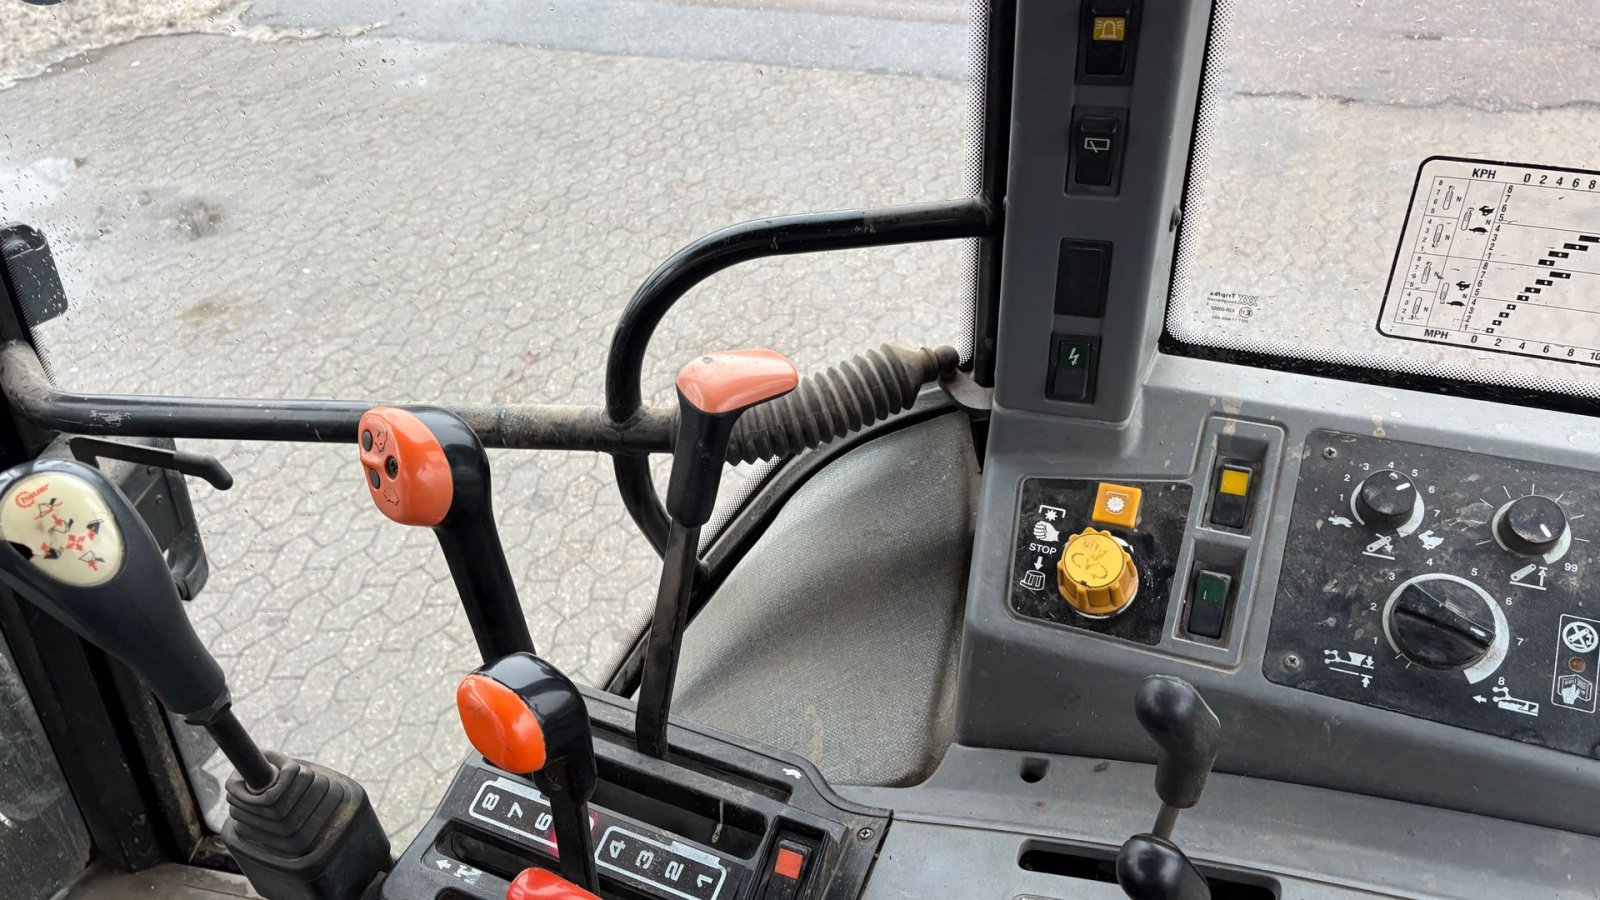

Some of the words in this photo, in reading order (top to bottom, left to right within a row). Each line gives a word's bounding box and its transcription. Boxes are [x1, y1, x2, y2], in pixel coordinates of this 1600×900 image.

[1472, 168, 1496, 179] KPH
[1524, 174, 1531, 183] 0
[1540, 175, 1548, 184] 2
[1556, 177, 1564, 186] 4
[1572, 178, 1580, 188] 6
[1588, 180, 1596, 190] 8
[1507, 185, 1514, 194] 8
[1424, 329, 1448, 339] MPH
[1471, 335, 1478, 344] 0
[1494, 338, 1502, 346] 2
[1518, 342, 1526, 350] 4
[1543, 345, 1550, 354] 6
[1567, 348, 1574, 357] 8
[1412, 469, 1418, 477] 5
[1029, 542, 1056, 555] STOP
[1471, 568, 1478, 576] 5
[1564, 562, 1578, 572] 99
[1389, 572, 1396, 580] 3
[1506, 598, 1512, 606] 6
[1518, 638, 1524, 646] 7
[1498, 677, 1505, 685] 8
[482, 792, 500, 811] 8
[507, 802, 524, 820] 7
[534, 812, 552, 831] 6
[609, 840, 626, 858] 4
[636, 850, 654, 869] 3
[664, 861, 684, 881] 2
[697, 874, 713, 888] 1
